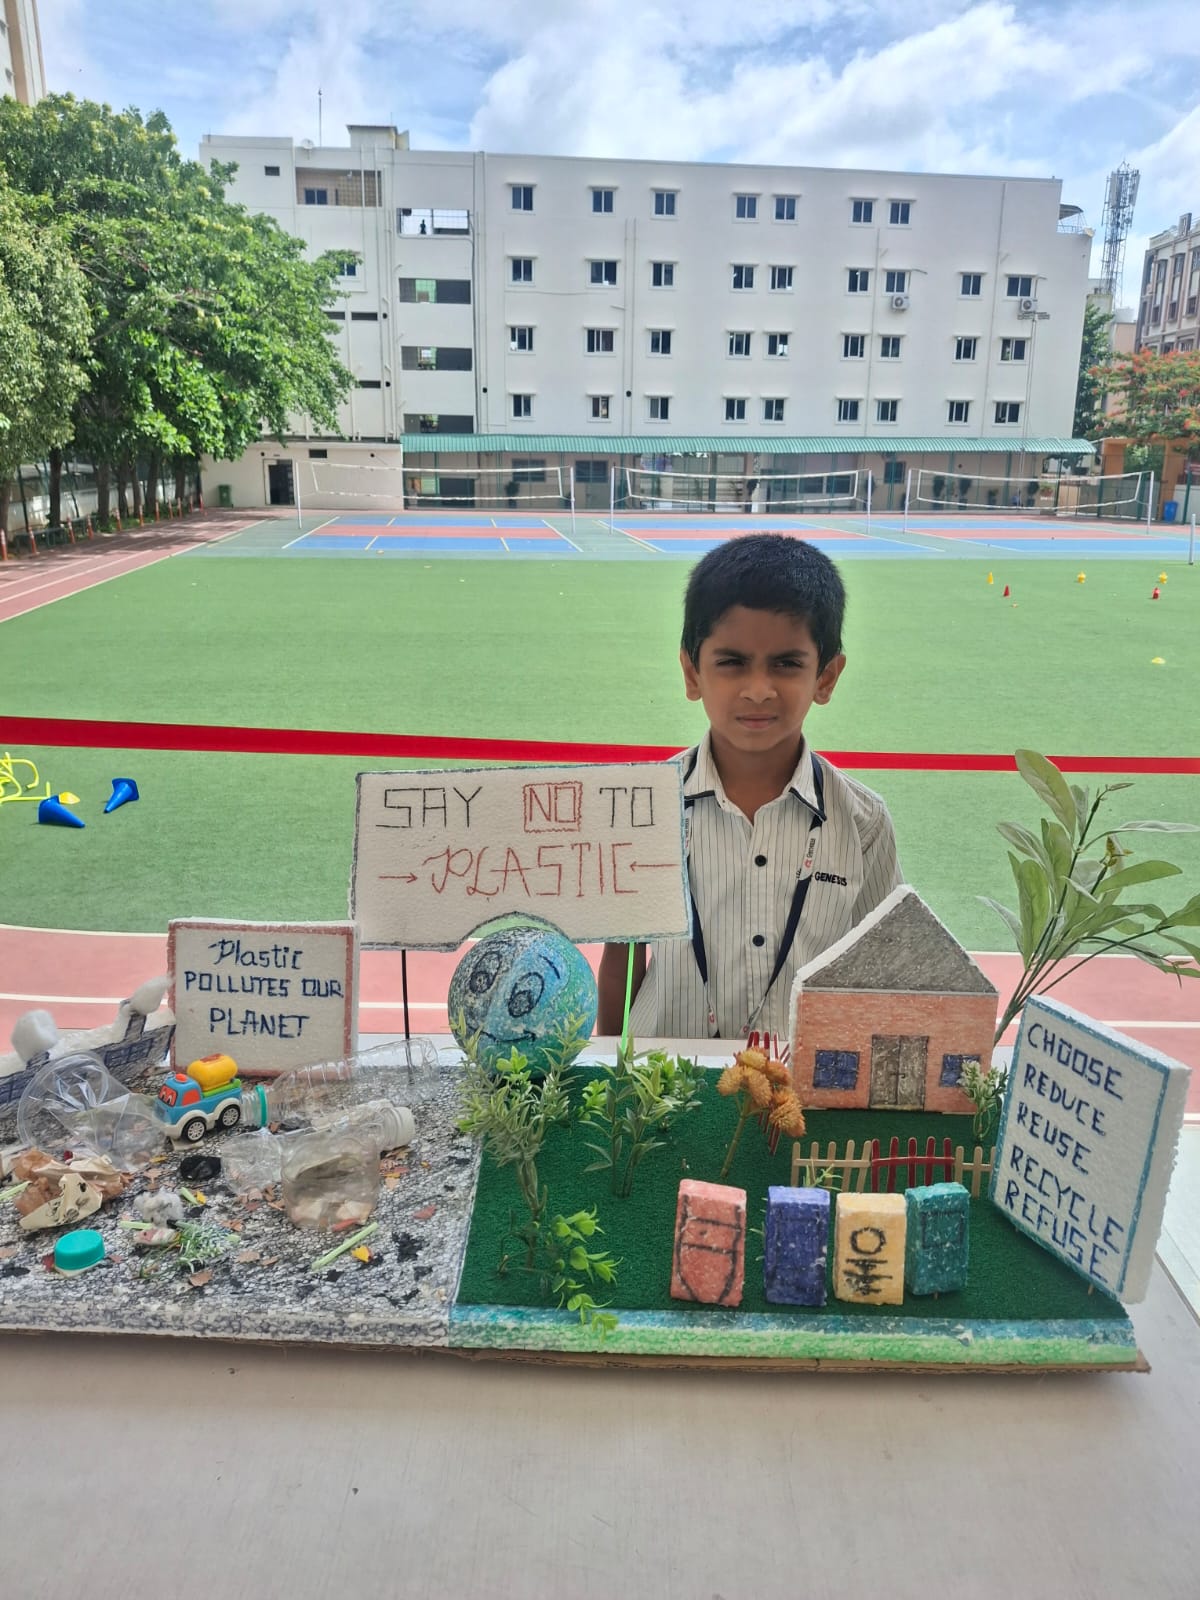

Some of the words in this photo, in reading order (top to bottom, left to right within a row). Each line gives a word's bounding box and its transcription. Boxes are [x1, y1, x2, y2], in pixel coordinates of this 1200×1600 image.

[376, 786, 483, 828] SAY
[528, 786, 577, 823] NO
[599, 786, 654, 828] TO
[422, 842, 638, 898] PLASTIC
[184, 971, 291, 997] POLLUTES
[301, 978, 344, 998] OUR
[208, 939, 303, 970] Plastic
[209, 1007, 310, 1039] PLANET
[1027, 1022, 1123, 1101] CHOOSE
[1023, 1063, 1106, 1137] REDUCE
[1016, 1102, 1091, 1175] REUSE
[1004, 1179, 1108, 1283] REFUSE
[1010, 1144, 1124, 1254] RECYCLE
